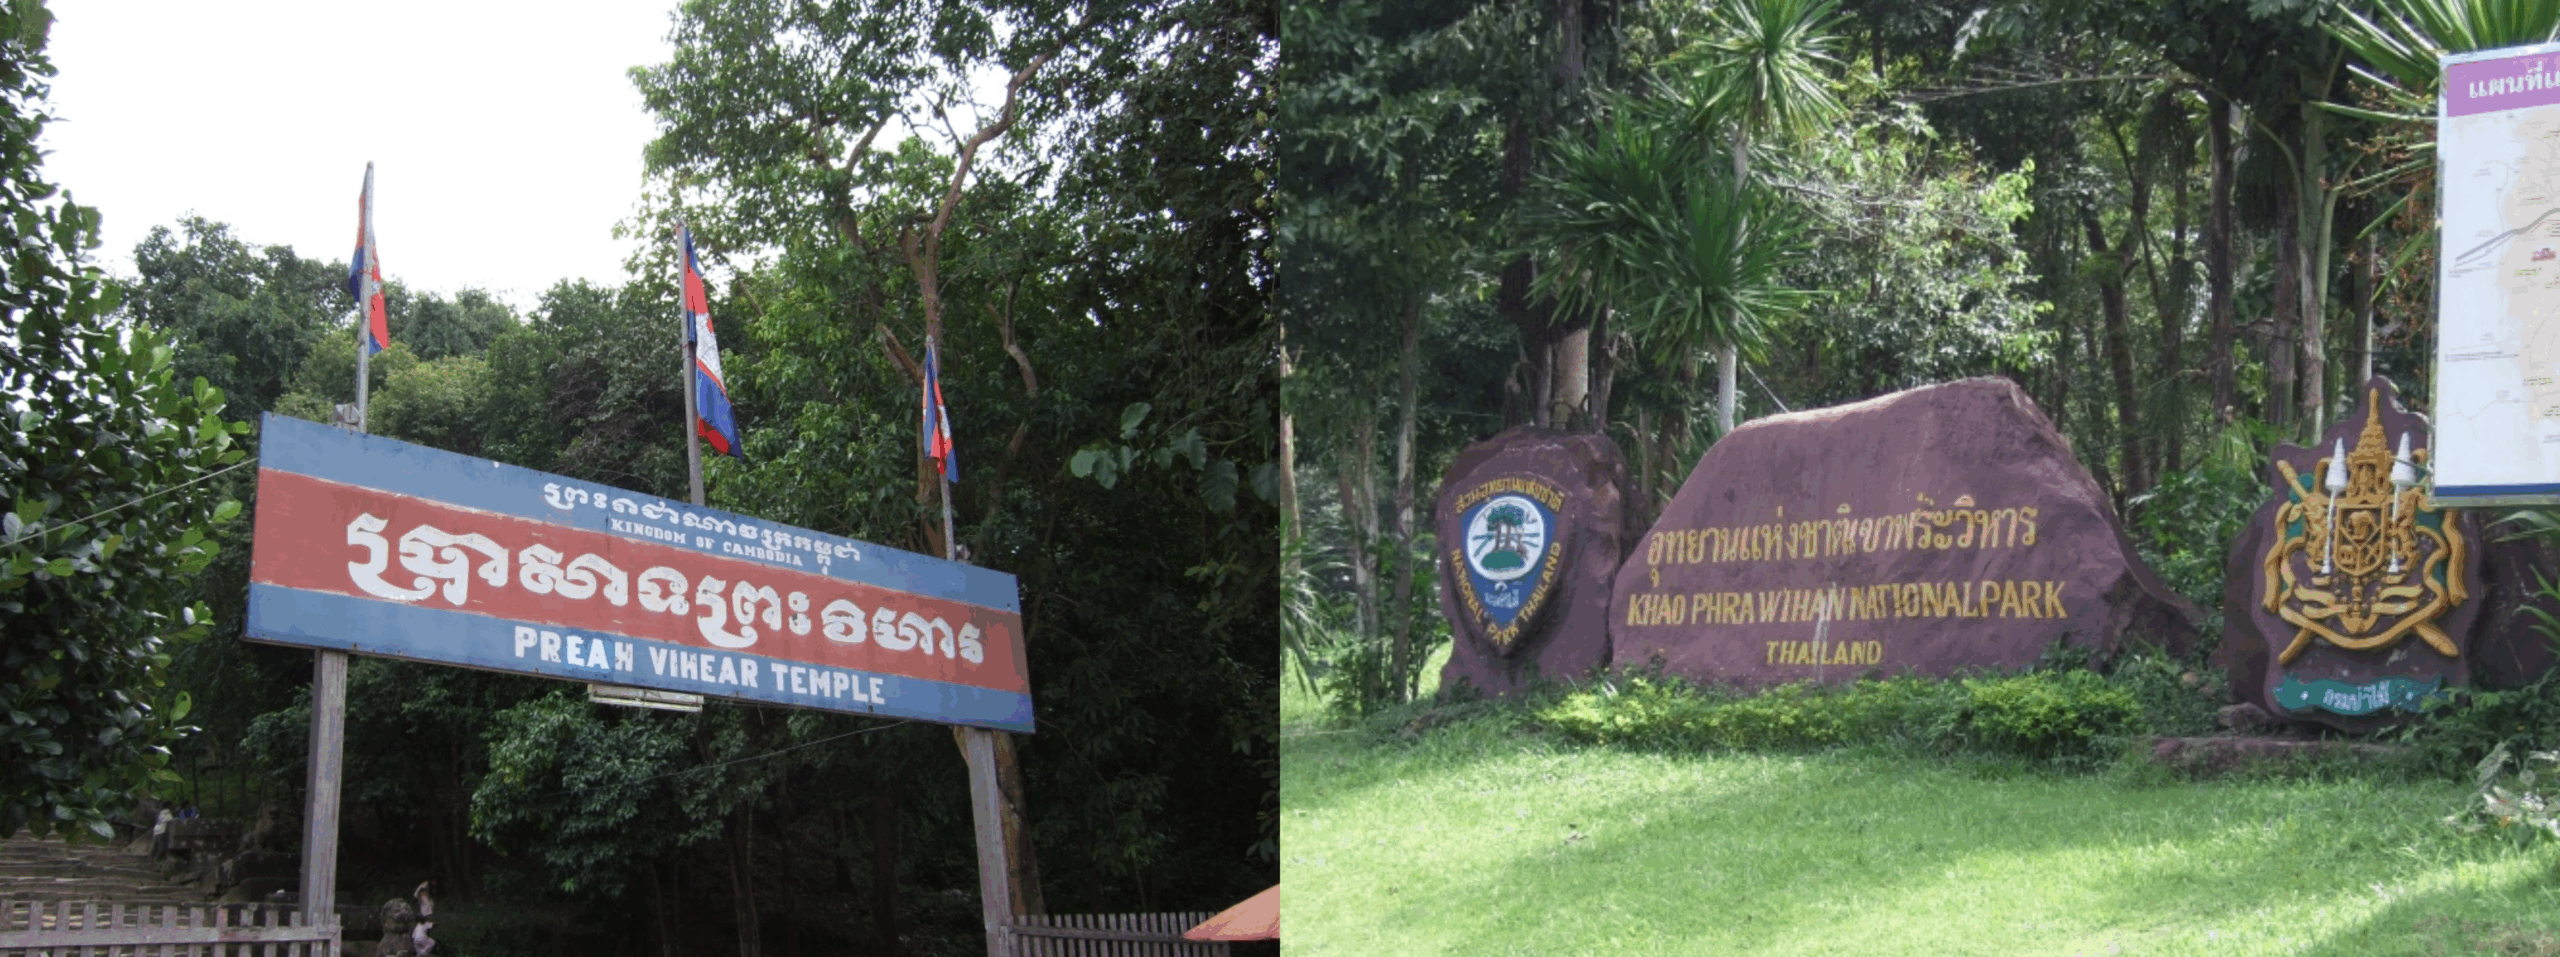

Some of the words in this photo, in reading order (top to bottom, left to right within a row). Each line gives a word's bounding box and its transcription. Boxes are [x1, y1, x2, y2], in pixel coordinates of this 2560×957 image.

[610, 518, 687, 545] KINGDOM
[696, 536, 716, 551] OF
[723, 541, 804, 567] CAMBODIA
[1451, 548, 1484, 624] NATIONAL
[1487, 621, 1520, 646] PARK
[1518, 541, 1562, 623] THAILAND
[1627, 593, 1686, 626] KHAO
[1691, 591, 1755, 625] PHRA
[1758, 586, 1847, 623] WIHAN
[514, 625, 634, 673] PREAH
[648, 646, 758, 689] VIHEAR
[771, 662, 886, 705] TEMPLE
[1766, 639, 1883, 666] THAILAND
